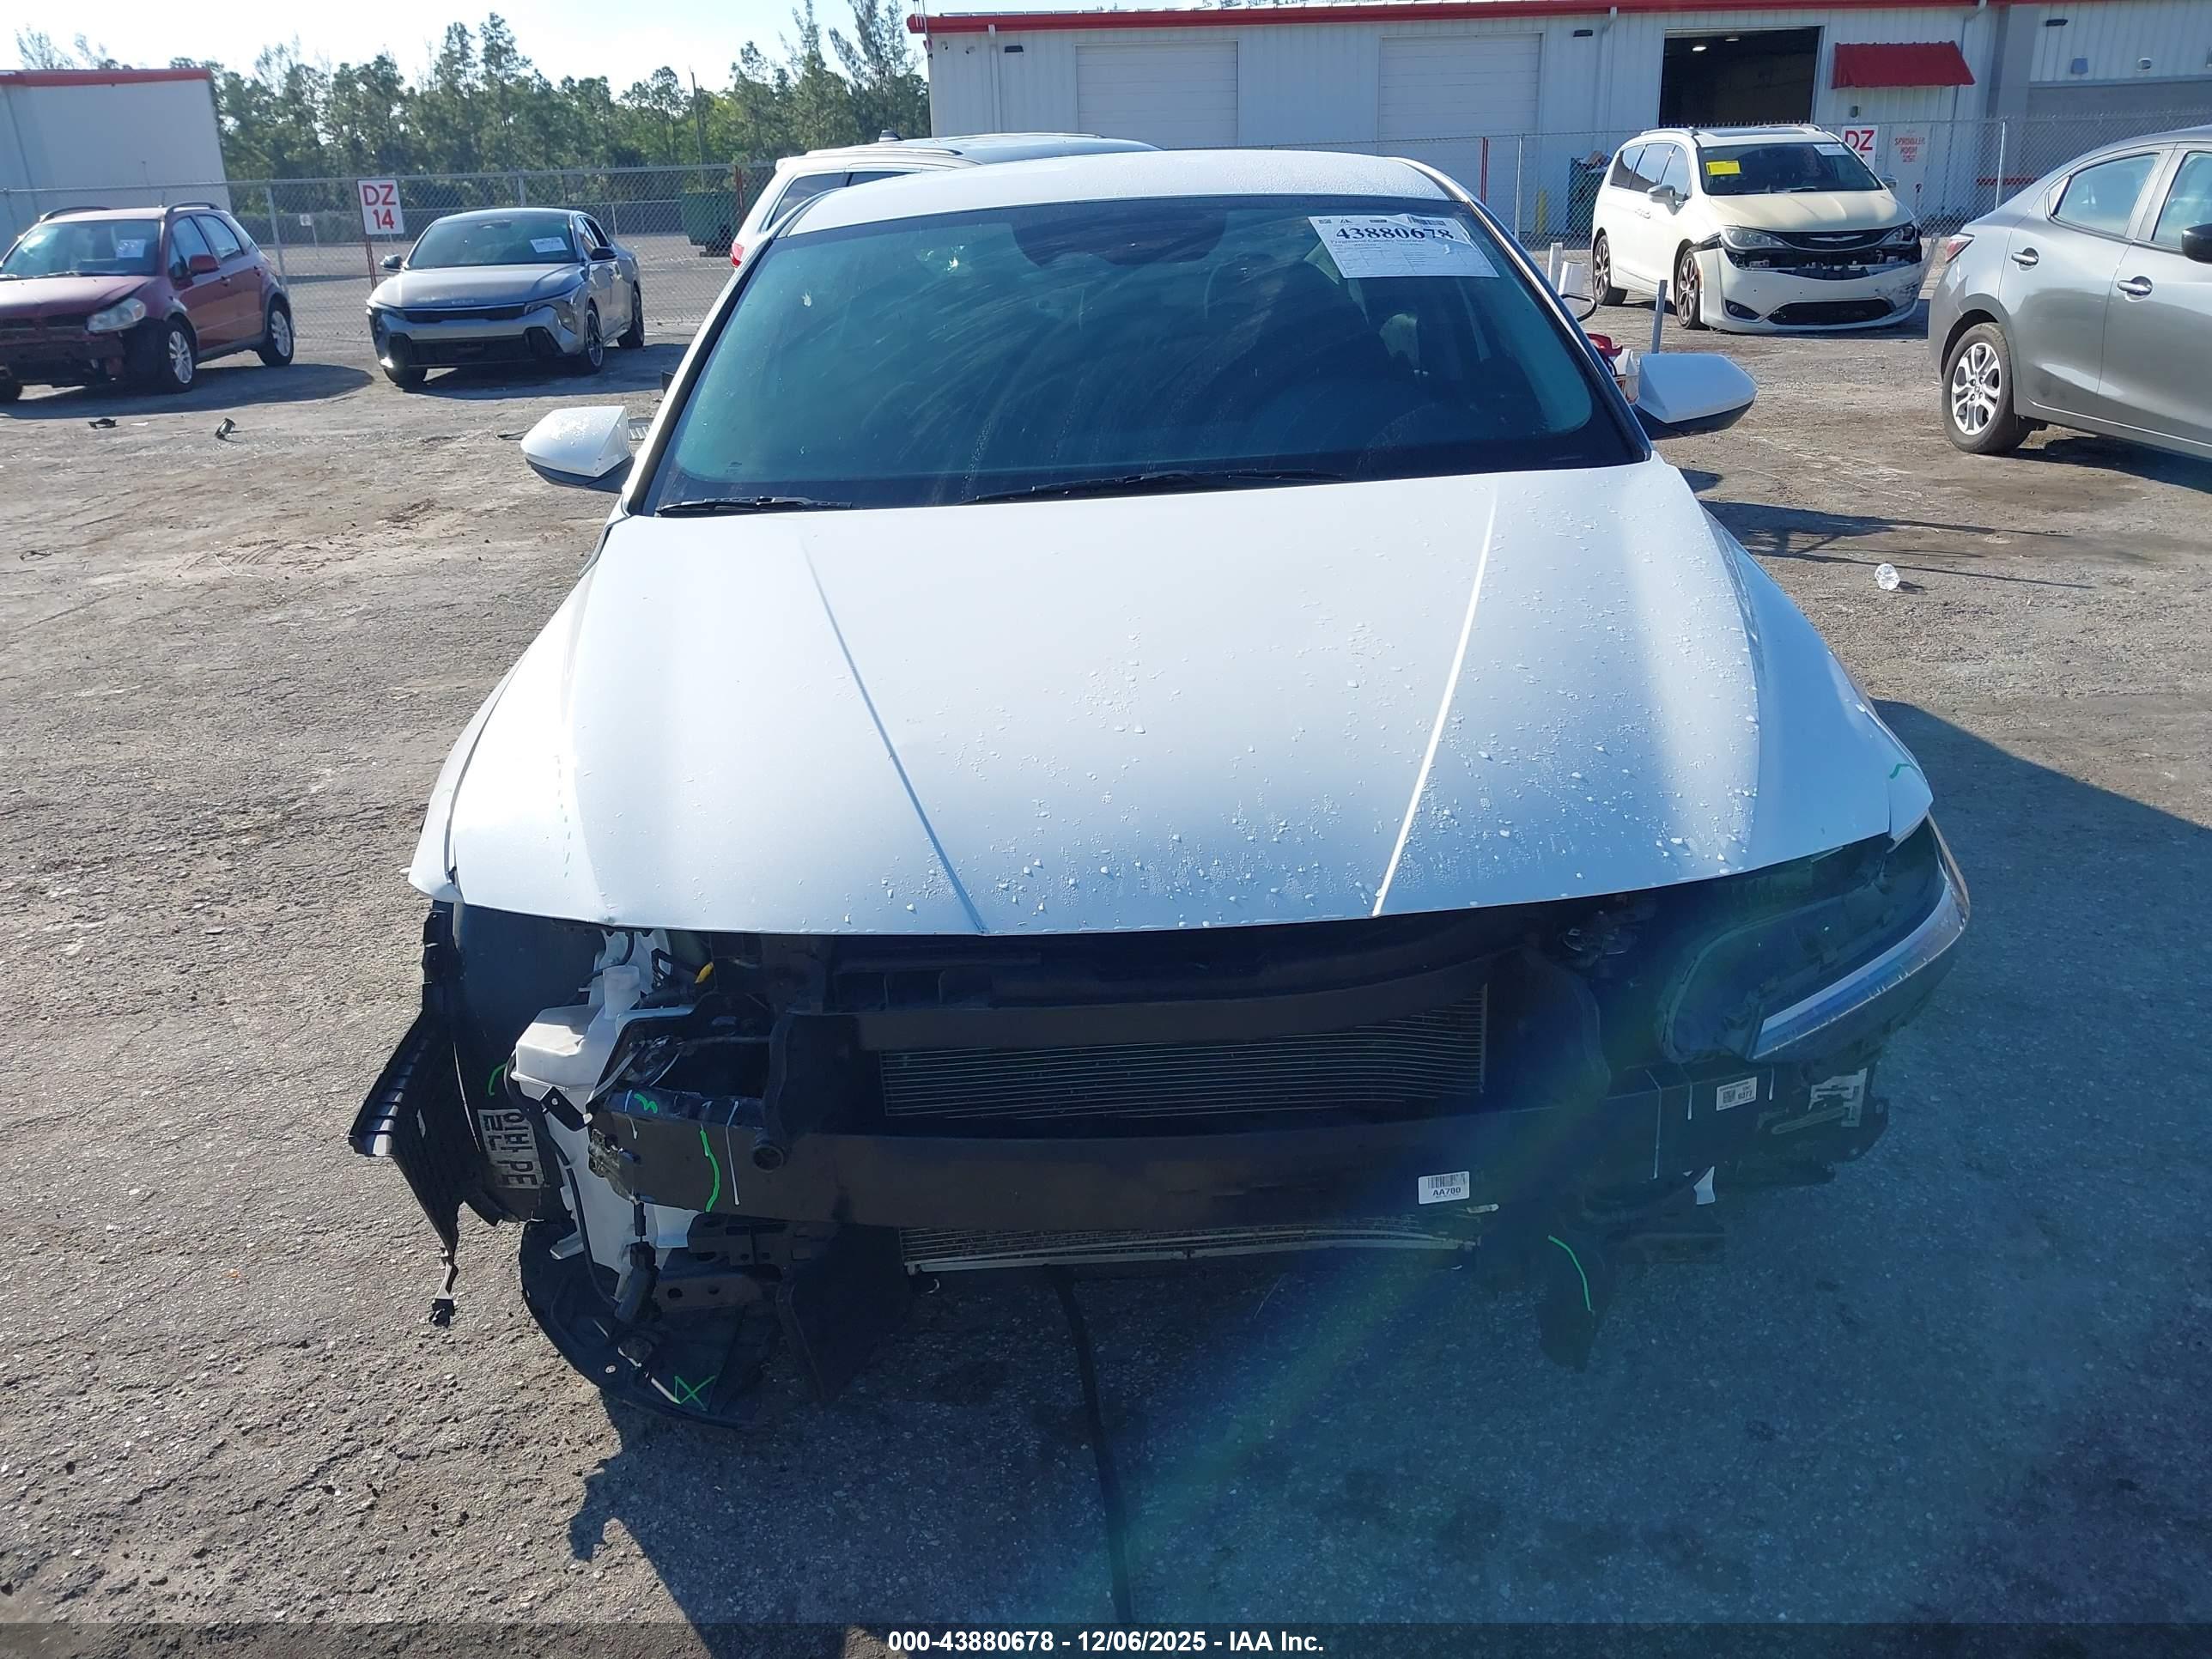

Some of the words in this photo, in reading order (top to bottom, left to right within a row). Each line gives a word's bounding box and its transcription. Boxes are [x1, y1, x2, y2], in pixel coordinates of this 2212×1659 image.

[1844, 130, 1875, 150] DZ
[362, 184, 397, 206] DZ
[372, 209, 395, 230] 14
[1336, 227, 1455, 240] 43880678
